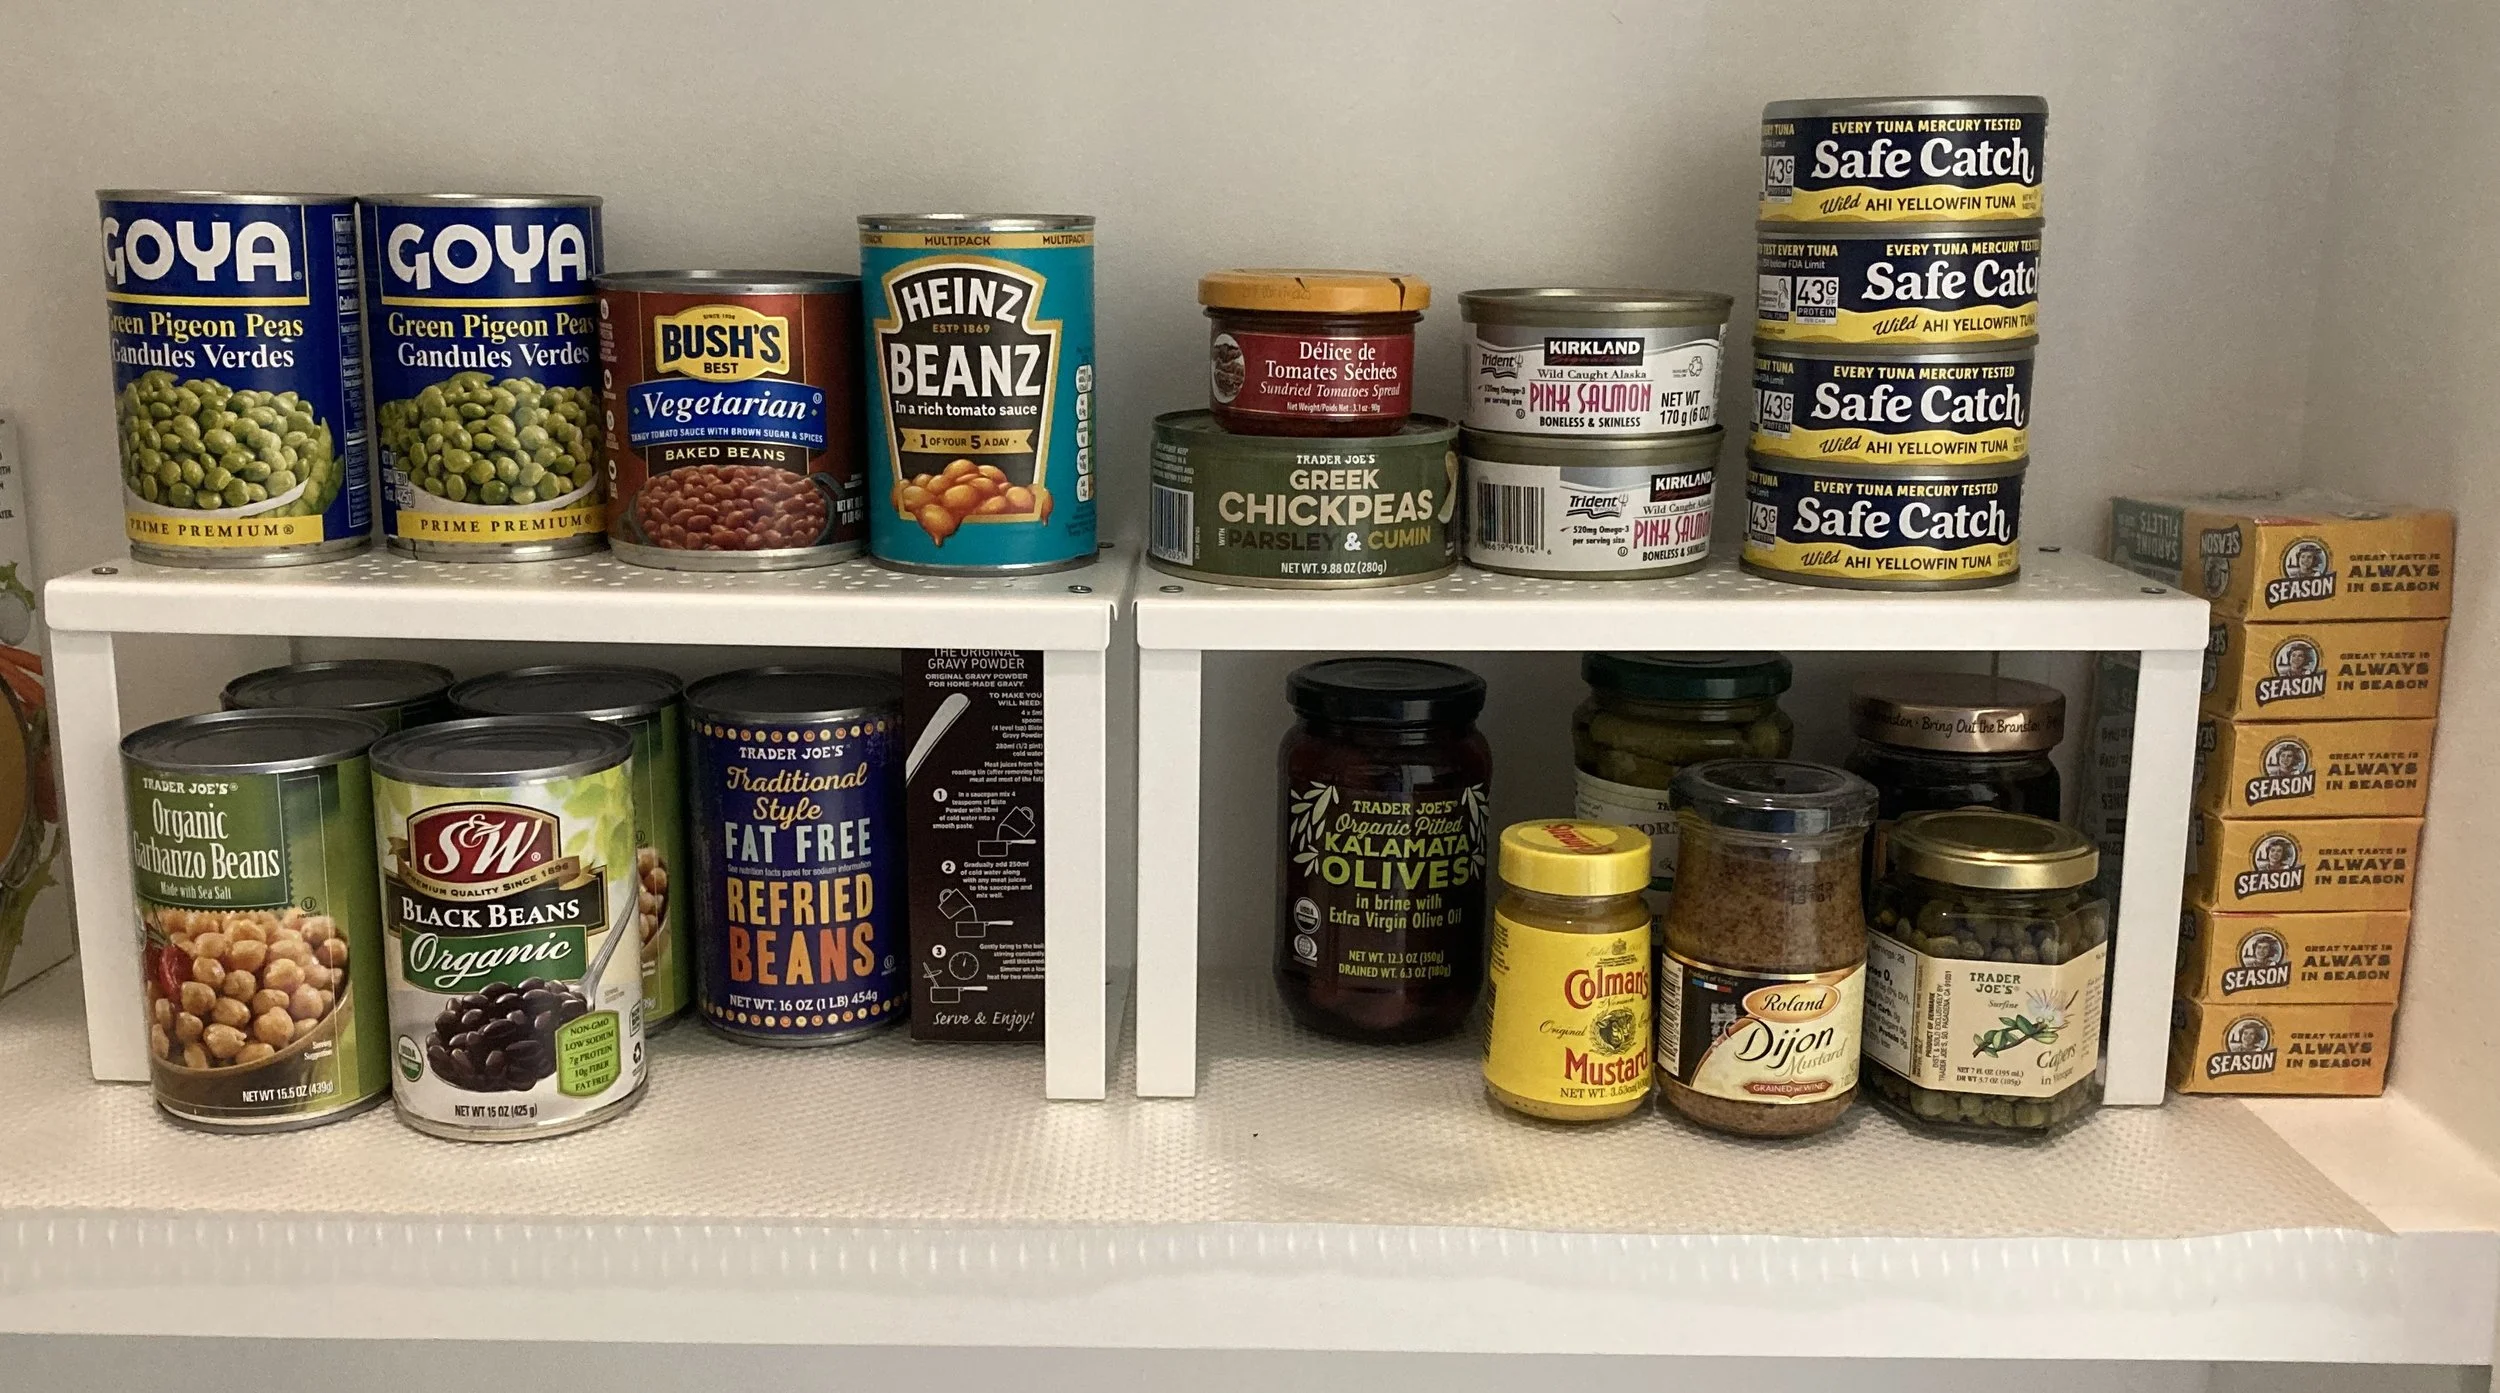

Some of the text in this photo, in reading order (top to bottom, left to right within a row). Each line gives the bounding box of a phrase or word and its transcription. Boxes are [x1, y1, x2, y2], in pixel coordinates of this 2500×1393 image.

[1832, 118, 2022, 135] EVERY TUNA MERCURY TESTED
[1811, 136, 2034, 184] Safe Catch
[1820, 192, 1862, 215] Wild
[1865, 198, 1892, 212] AHI
[1897, 196, 1981, 212] YELLOWFIN
[1985, 195, 2017, 210] TUNA
[102, 216, 292, 286] GOYA
[924, 235, 991, 246] MULTIPACK
[388, 223, 587, 290] GOYA
[901, 277, 1023, 324] HEINZ
[1797, 307, 1836, 317] PROTEIN
[388, 311, 594, 344] Green Pigeon Peas
[111, 337, 295, 368] Gandules Verdes
[662, 323, 781, 364] BUSH'S
[1299, 341, 1376, 361] Délice de
[1549, 341, 1640, 355] KIRKLAND
[398, 342, 590, 368] Gandules Verdes
[704, 362, 739, 374] BEST
[890, 343, 1041, 398] BEANZ
[1265, 360, 1398, 381] Tomates Séchées
[1537, 369, 1647, 382] Wild Caught Alaska
[1833, 365, 2016, 380] EVERY TUNA MERCURY TESTED
[1259, 381, 1401, 400] Sundried Tomatoes Spread
[1529, 383, 1652, 414] PINK SALMON
[1661, 390, 1701, 408] NET WT
[642, 390, 806, 423] Vegetarian
[895, 401, 1038, 416] In a rich tomato sauce
[1810, 382, 2025, 427] Safe Catch
[1539, 416, 1641, 428] BONELESS & SKINLESS
[651, 429, 678, 439] TOMATO
[680, 427, 706, 437] SAUCE
[708, 427, 729, 437] WITH
[731, 427, 762, 437] BROWN
[763, 428, 790, 440] SUGAR
[792, 431, 798, 440] &
[799, 432, 823, 443] SPICES
[920, 434, 1010, 450] 1 OF YOUR 5 A DAY
[1819, 435, 1862, 454] Wild
[1866, 441, 1893, 454] AHI
[1898, 441, 1978, 455] YELLOWFIN
[1981, 440, 2009, 453] TUNA
[665, 446, 786, 462] BAKED BEANS
[1296, 454, 1376, 465] TRADER JOE'S
[1289, 468, 1380, 491] GREEK
[1218, 487, 1434, 527] CHICKPEAS
[1569, 495, 1619, 508] Trident
[1218, 527, 1226, 547] WITH
[1228, 528, 1341, 551] PARSLEY
[1343, 531, 1362, 551] &
[1367, 525, 1431, 550] CUMIN
[1281, 560, 1388, 576] NET WT. 9.88 OZ (280g)
[2347, 563, 2440, 579] ALWAYS
[2268, 575, 2334, 604] SEASON
[2347, 580, 2440, 593] IN SEASON
[927, 658, 1025, 669] GRAVY POWDER
[2338, 662, 2430, 677] ALWAYS
[2259, 673, 2324, 702] SEASON
[2337, 679, 2429, 692] IN SEASON
[726, 762, 868, 793] Traditional
[2327, 762, 2418, 777] ALWAYS
[2249, 775, 2313, 801] SEASON
[2326, 778, 2417, 791] IN SEASON
[152, 798, 230, 844] Organic
[753, 796, 823, 831] Style
[1335, 813, 1463, 840] Organic Pitted
[725, 817, 872, 864] FAT FREE
[1325, 832, 1470, 858] KALAMATA
[133, 831, 280, 880] Garbanzo Beans
[1322, 855, 1470, 890] OLIVES
[727, 873, 874, 926] REFRIED
[1356, 893, 1442, 911] in brine with
[401, 896, 580, 928] BLACK BEANS
[1329, 906, 1360, 927] Extra
[1365, 911, 1407, 933] Virgin
[1412, 910, 1443, 929] Olive
[1447, 907, 1462, 925] Oil
[409, 932, 572, 988] Organic
[729, 921, 875, 986] BEANS
[1564, 966, 1649, 1010] Colman's
[1969, 972, 2021, 984] TRADER
[1975, 983, 2014, 995] JOE'S
[729, 990, 878, 1012] NET WT. 16 OZ (1 LB) 454g
[1759, 993, 1828, 1012] Roland
[570, 1018, 610, 1037] NON-GMO
[933, 1009, 1035, 1032] Serve & Enjoy!
[565, 1030, 614, 1052] LOW SODIUM
[1733, 1016, 1834, 1070] Dijon
[1564, 1037, 1649, 1086] Mustard
[1560, 1087, 1608, 1099] NET WT.
